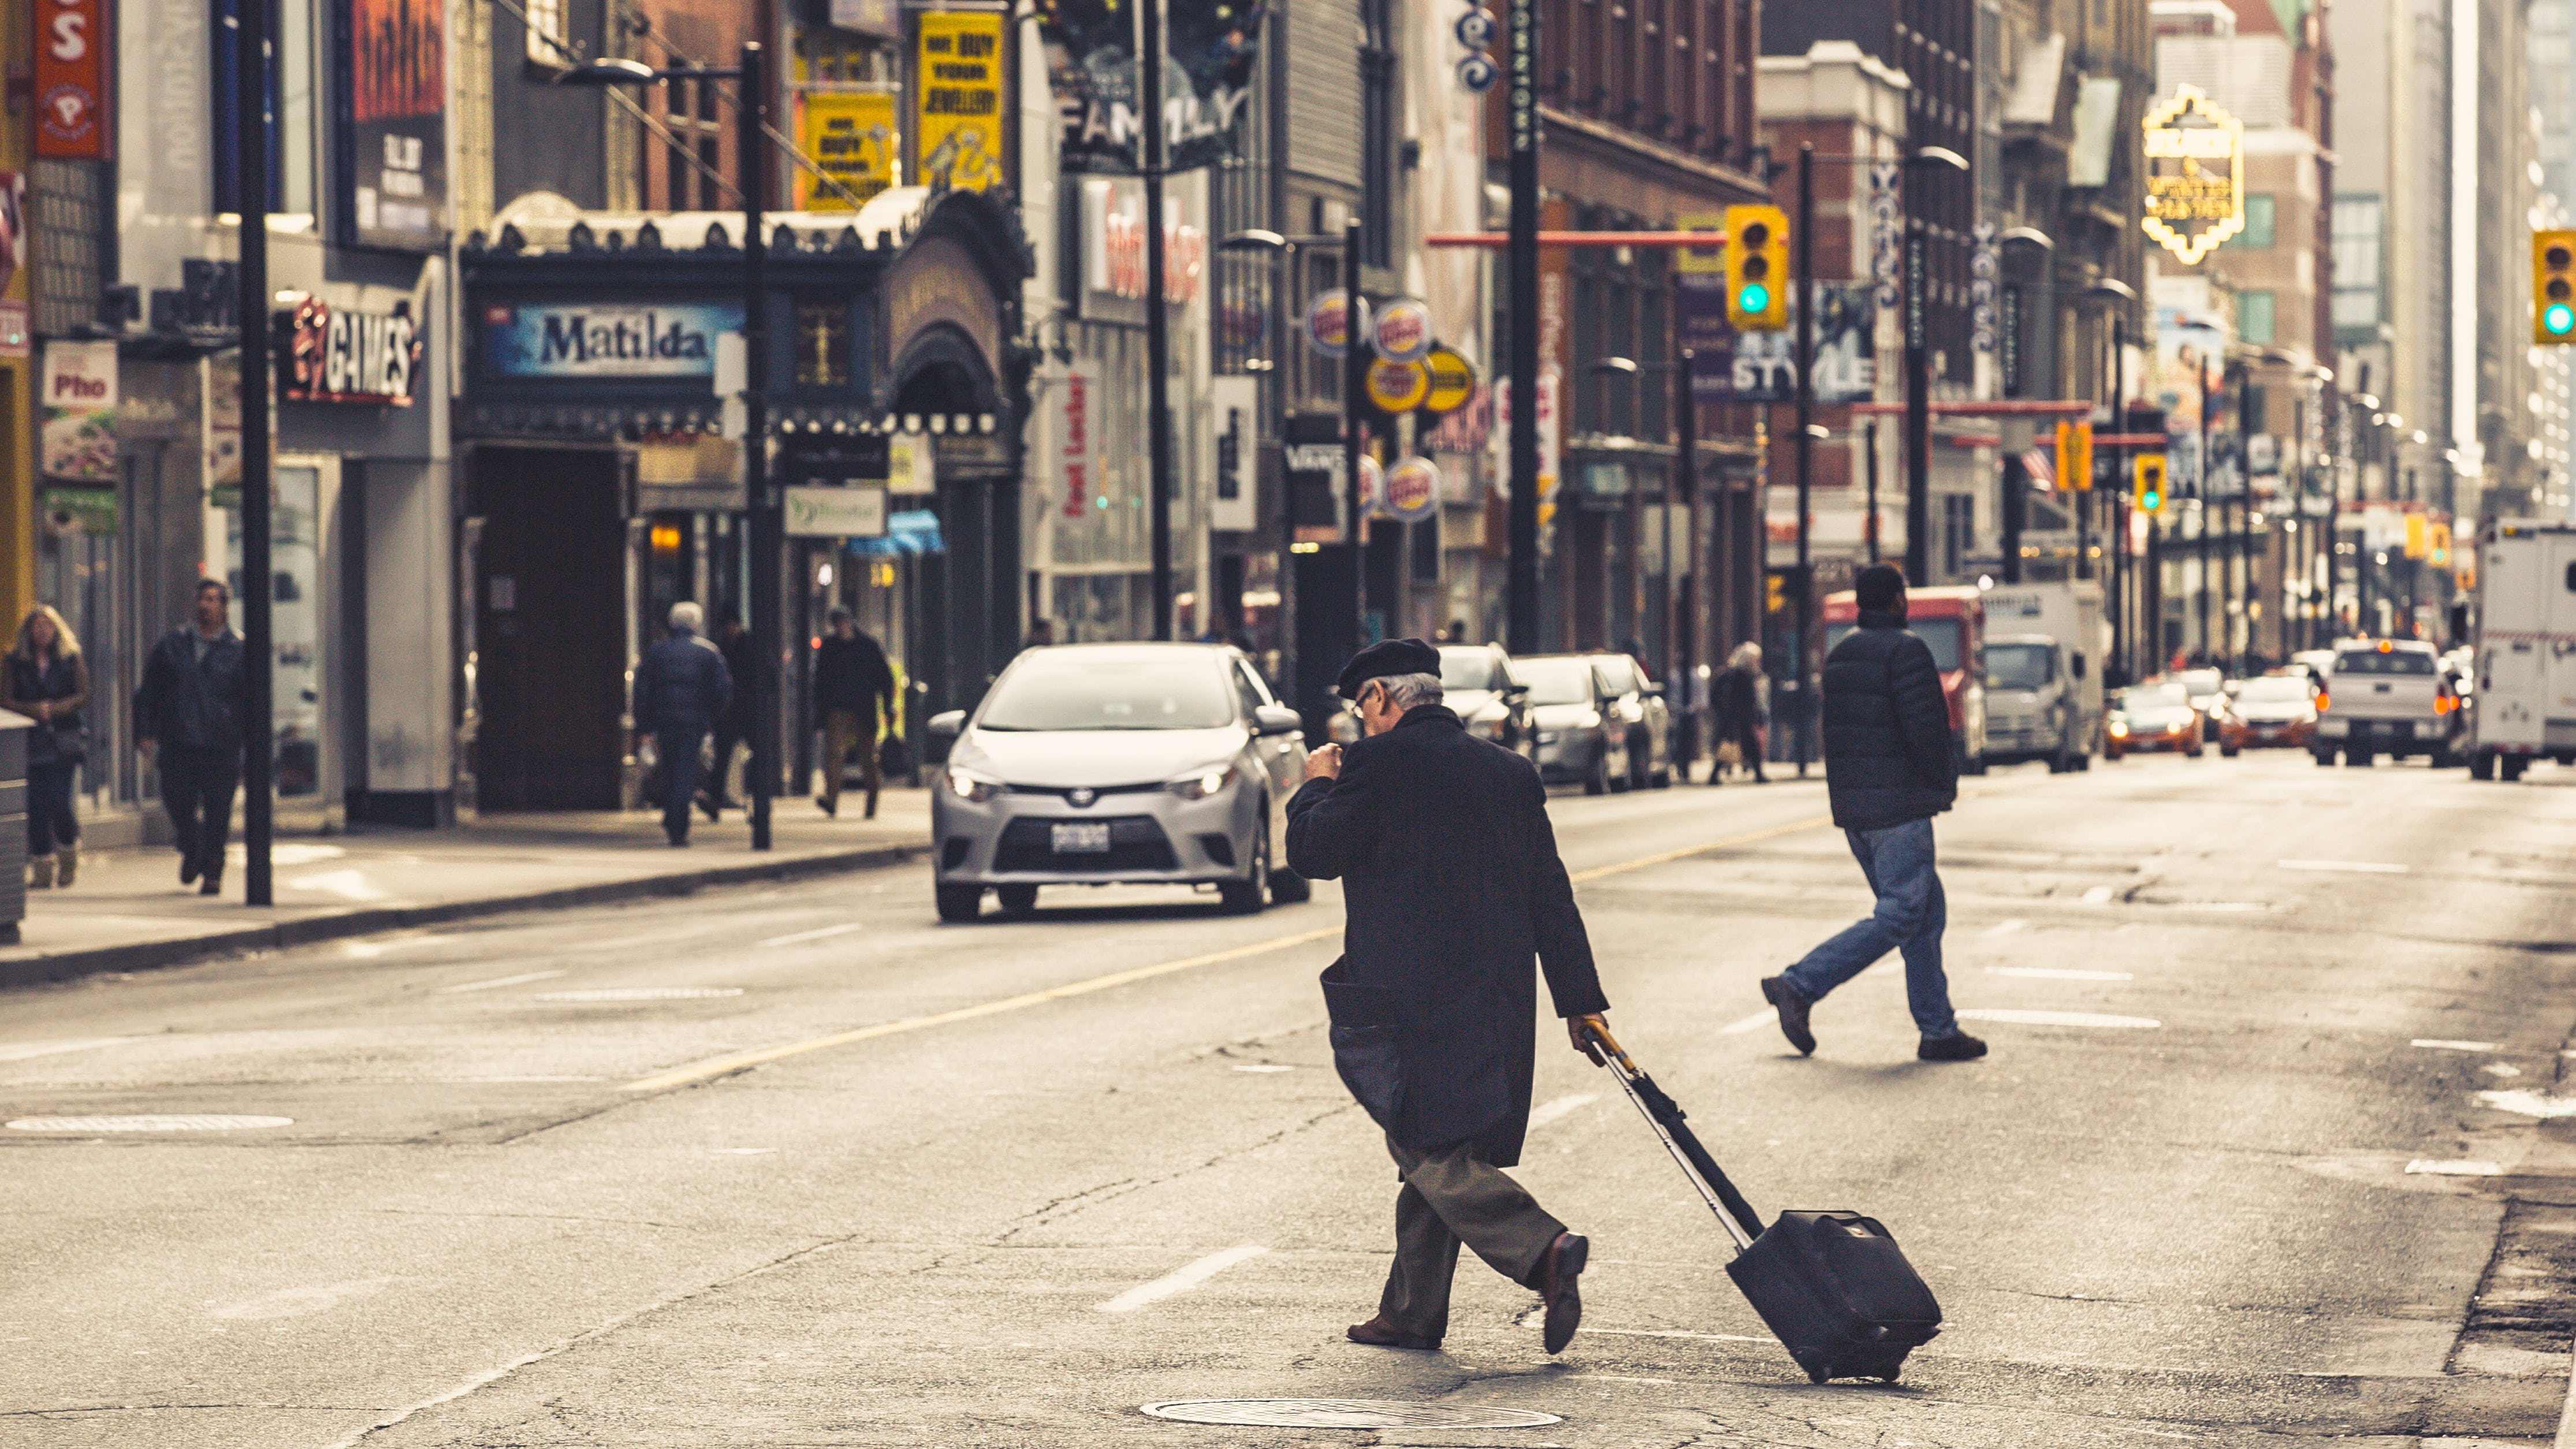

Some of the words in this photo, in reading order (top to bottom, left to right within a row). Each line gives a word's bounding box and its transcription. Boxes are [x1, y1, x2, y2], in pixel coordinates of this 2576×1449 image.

[326, 310, 416, 397] GAMES
[540, 312, 709, 363] Matilda
[54, 374, 106, 398] Pho
